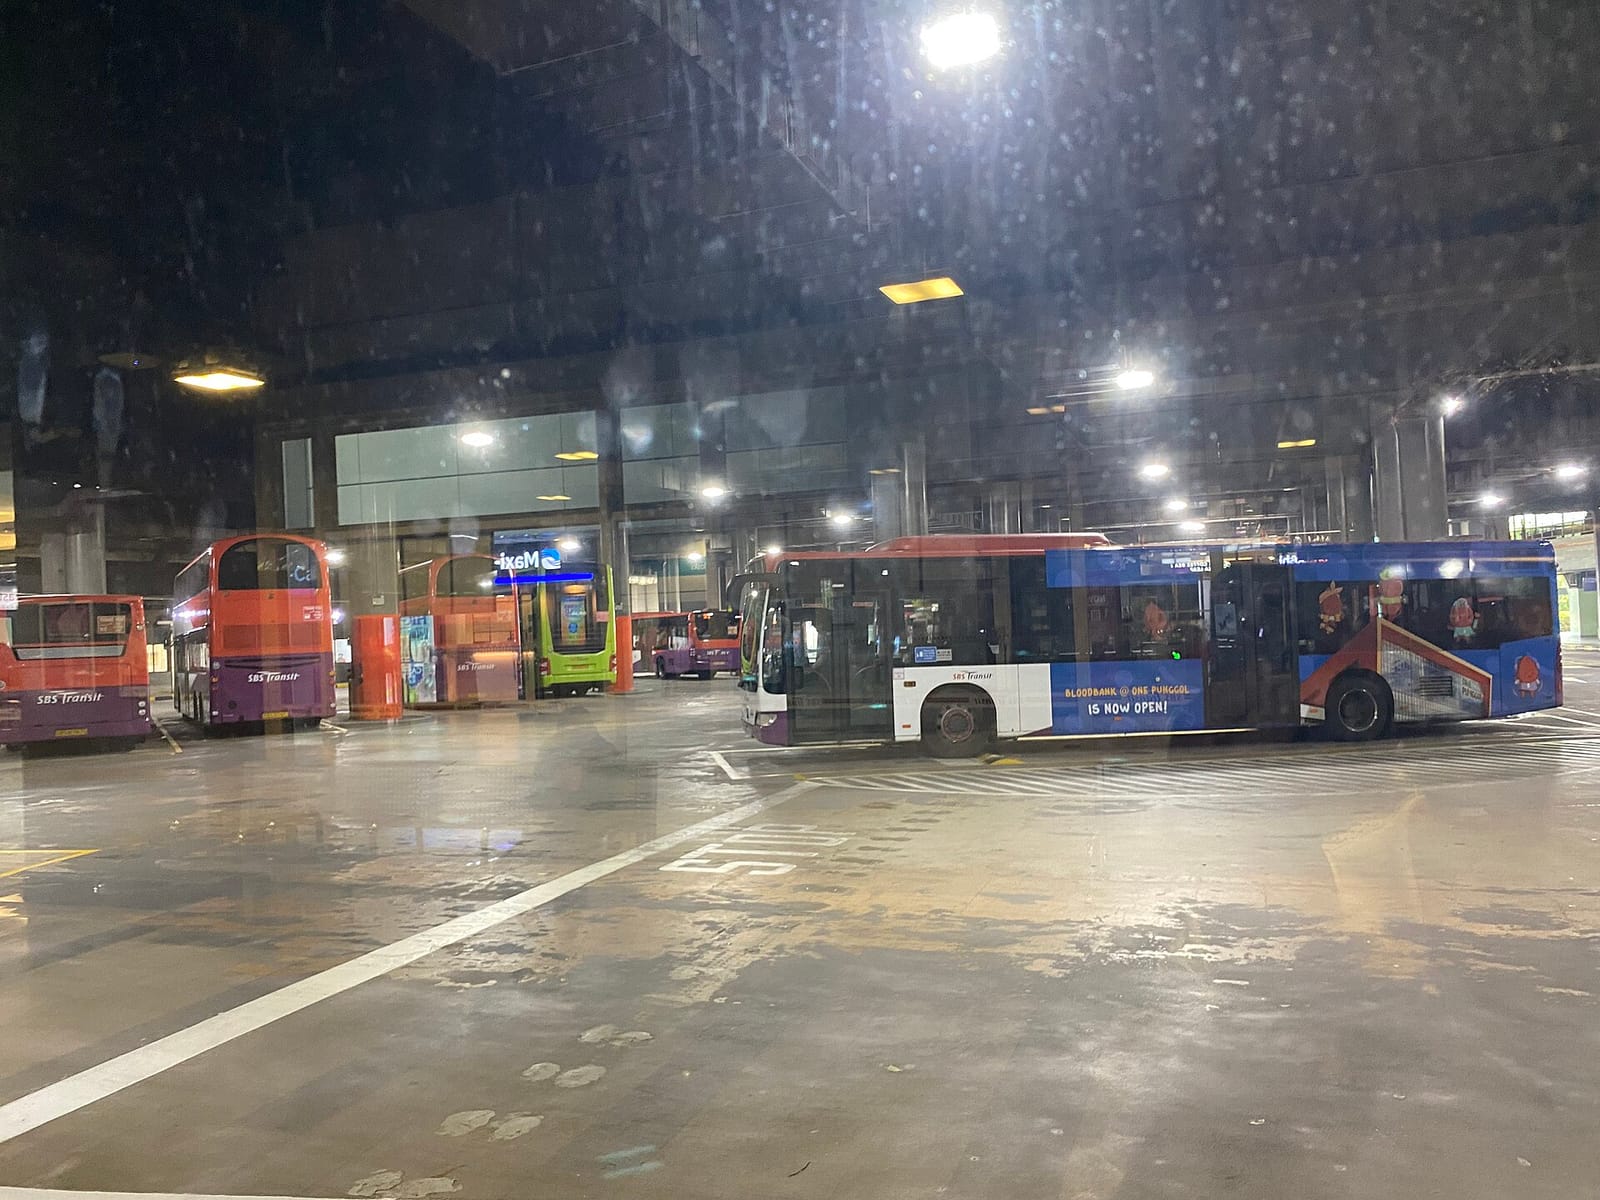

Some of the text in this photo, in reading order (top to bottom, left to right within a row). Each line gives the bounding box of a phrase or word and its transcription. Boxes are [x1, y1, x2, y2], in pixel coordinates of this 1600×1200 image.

[247, 671, 300, 683] SBS Transit
[37, 690, 104, 705] SBS Transit
[1065, 687, 1117, 698] BLOODBANK
[1132, 685, 1149, 696] ONE
[1151, 684, 1190, 695] PUNGGOL
[1088, 700, 1168, 715] IS NOW OPEN!
